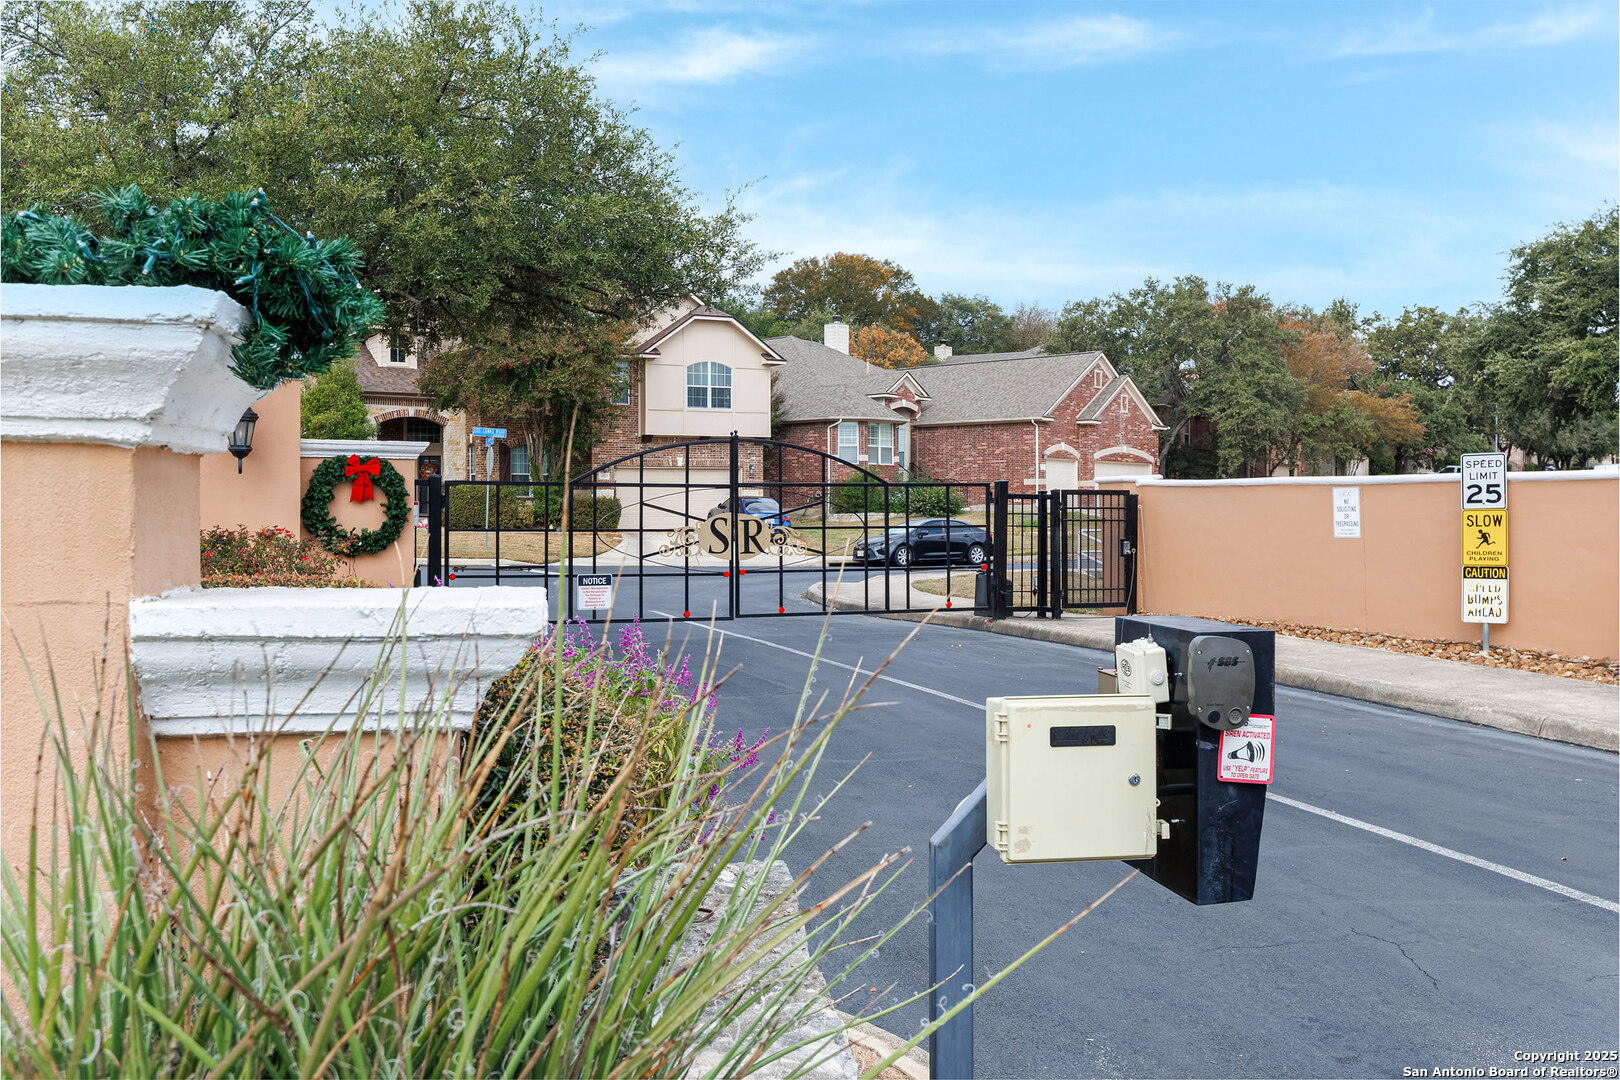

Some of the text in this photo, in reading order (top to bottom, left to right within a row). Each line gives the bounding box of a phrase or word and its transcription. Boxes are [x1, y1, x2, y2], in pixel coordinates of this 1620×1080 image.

[1465, 459, 1502, 469] SPEED
[1469, 471, 1498, 480] LIMIT
[1466, 483, 1502, 504] 25
[1466, 514, 1503, 527] SLOW
[1465, 567, 1506, 579] CAUTION
[1225, 730, 1271, 740] SIREN ACTIVATED
